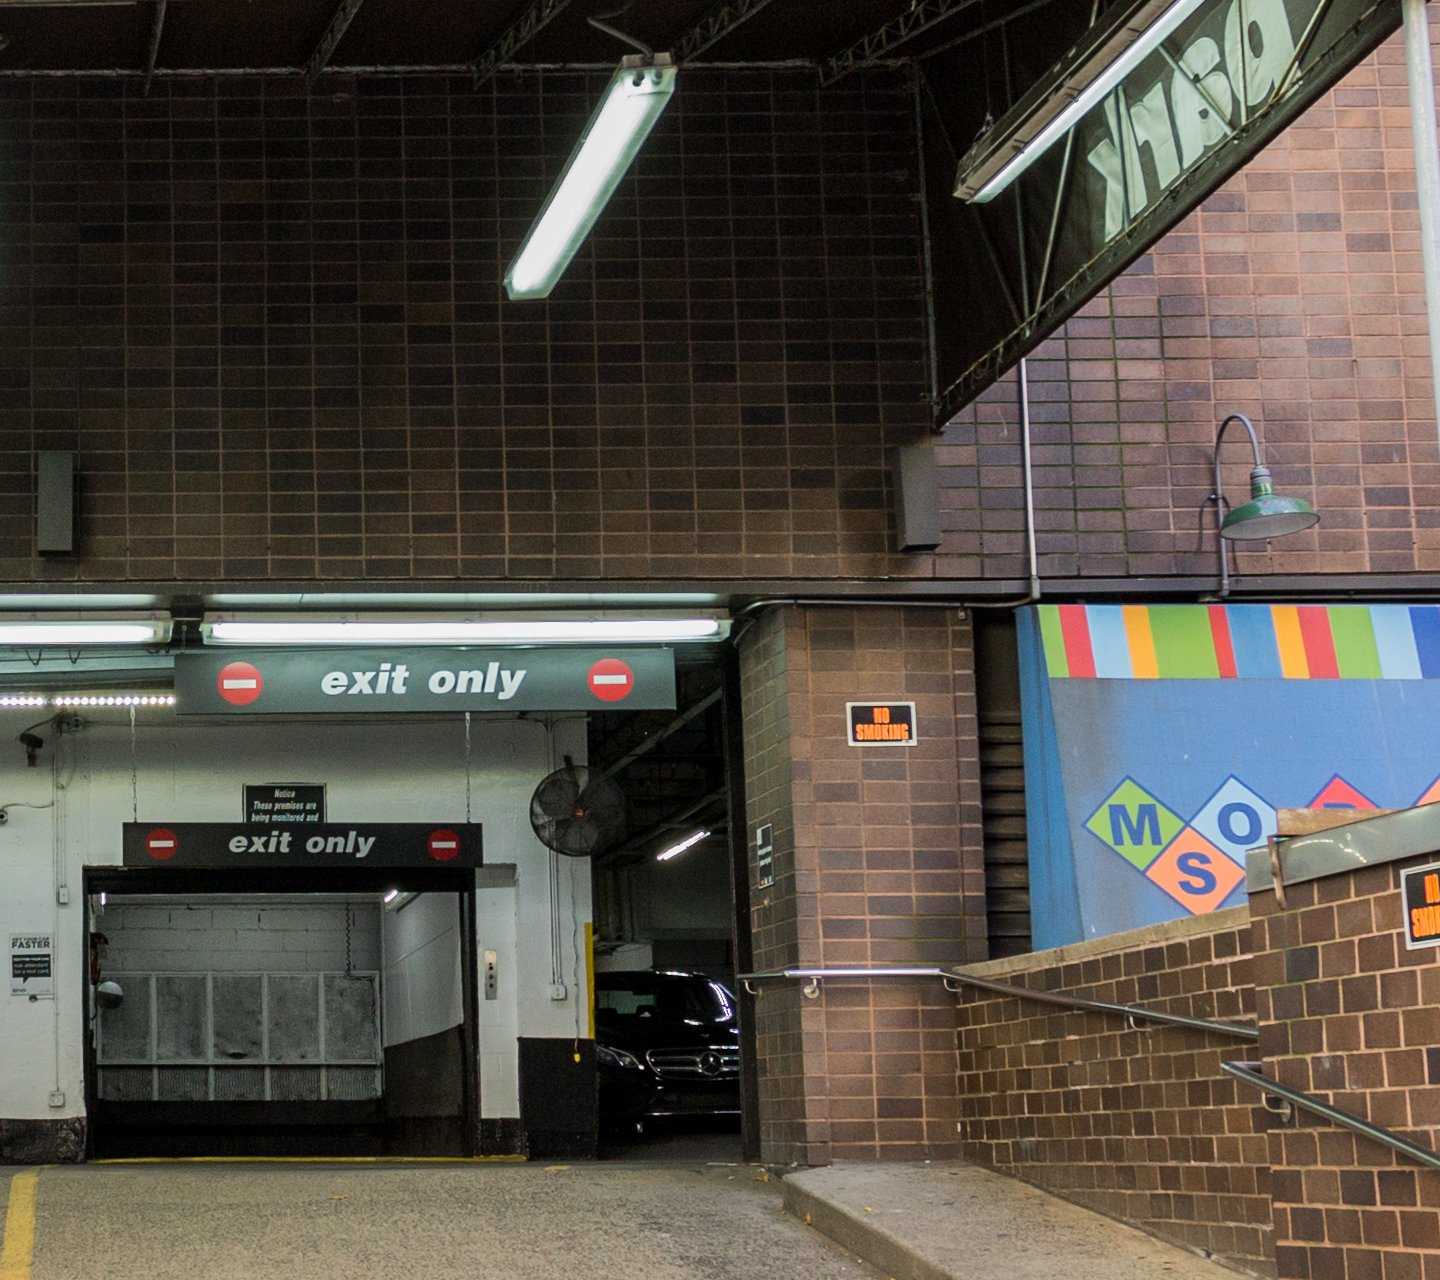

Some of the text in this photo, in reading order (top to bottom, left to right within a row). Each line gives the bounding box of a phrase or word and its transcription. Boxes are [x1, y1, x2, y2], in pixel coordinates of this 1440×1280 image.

[321, 662, 527, 700] exit only
[873, 707, 890, 724] NO
[855, 723, 909, 740] SMOKING
[228, 830, 376, 858] exit only
